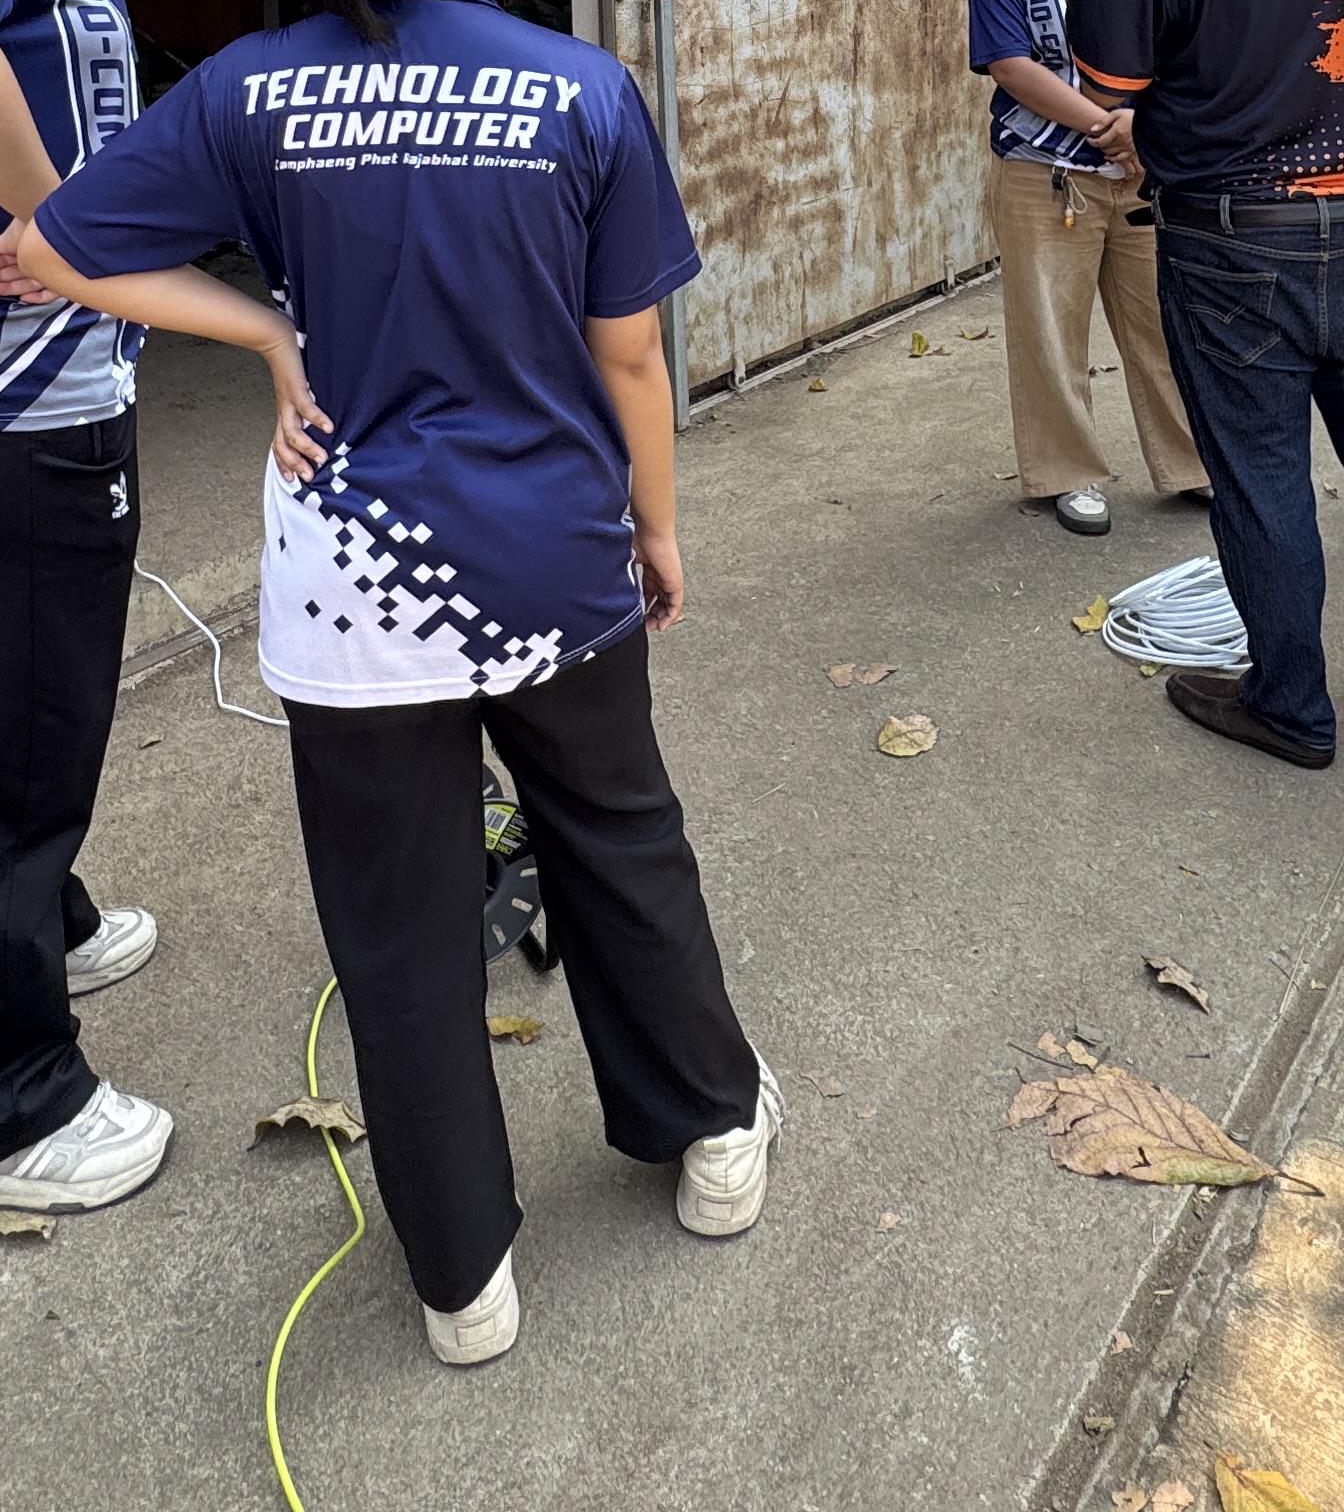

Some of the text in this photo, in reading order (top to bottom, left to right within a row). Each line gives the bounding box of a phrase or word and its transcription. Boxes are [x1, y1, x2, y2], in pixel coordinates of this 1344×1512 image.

[243, 63, 581, 115] TECHNOLOGY
[283, 109, 541, 150] COMPUTER
[360, 152, 398, 166] Phet
[402, 152, 469, 169] Rajabhat
[473, 154, 557, 174] University
